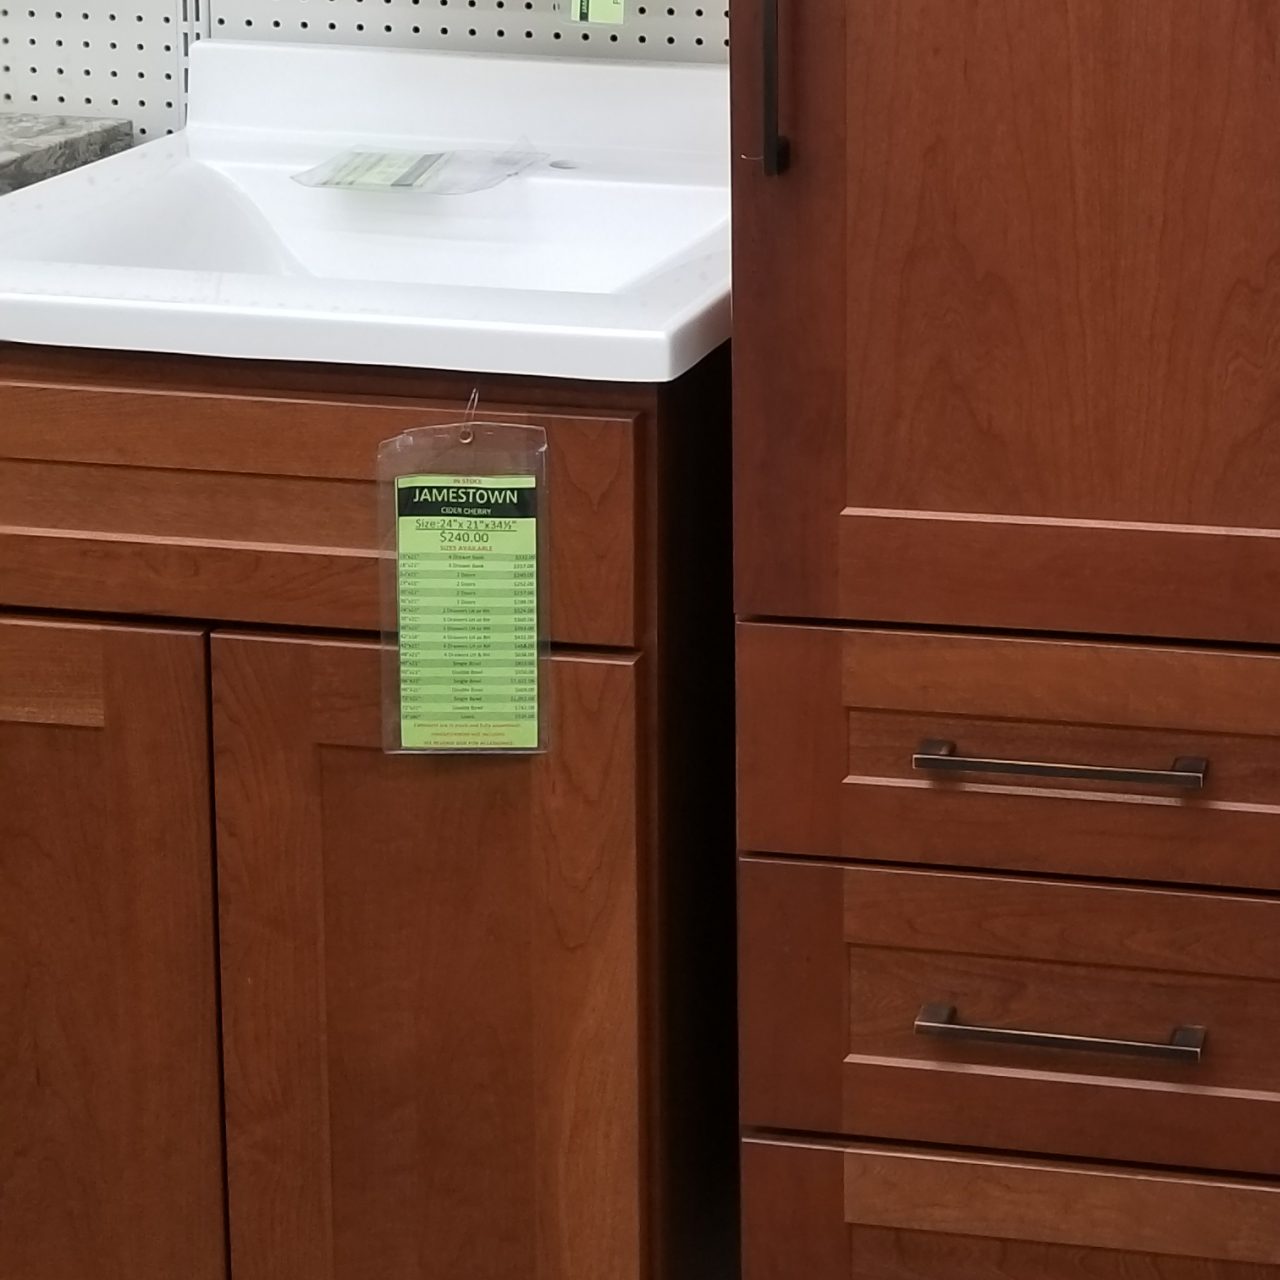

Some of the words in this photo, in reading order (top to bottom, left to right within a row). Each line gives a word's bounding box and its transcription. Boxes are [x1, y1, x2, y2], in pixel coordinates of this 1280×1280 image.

[413, 488, 518, 504] JAMESTOWN
[464, 507, 492, 515] CHERRY
[440, 530, 489, 542] $240.00
